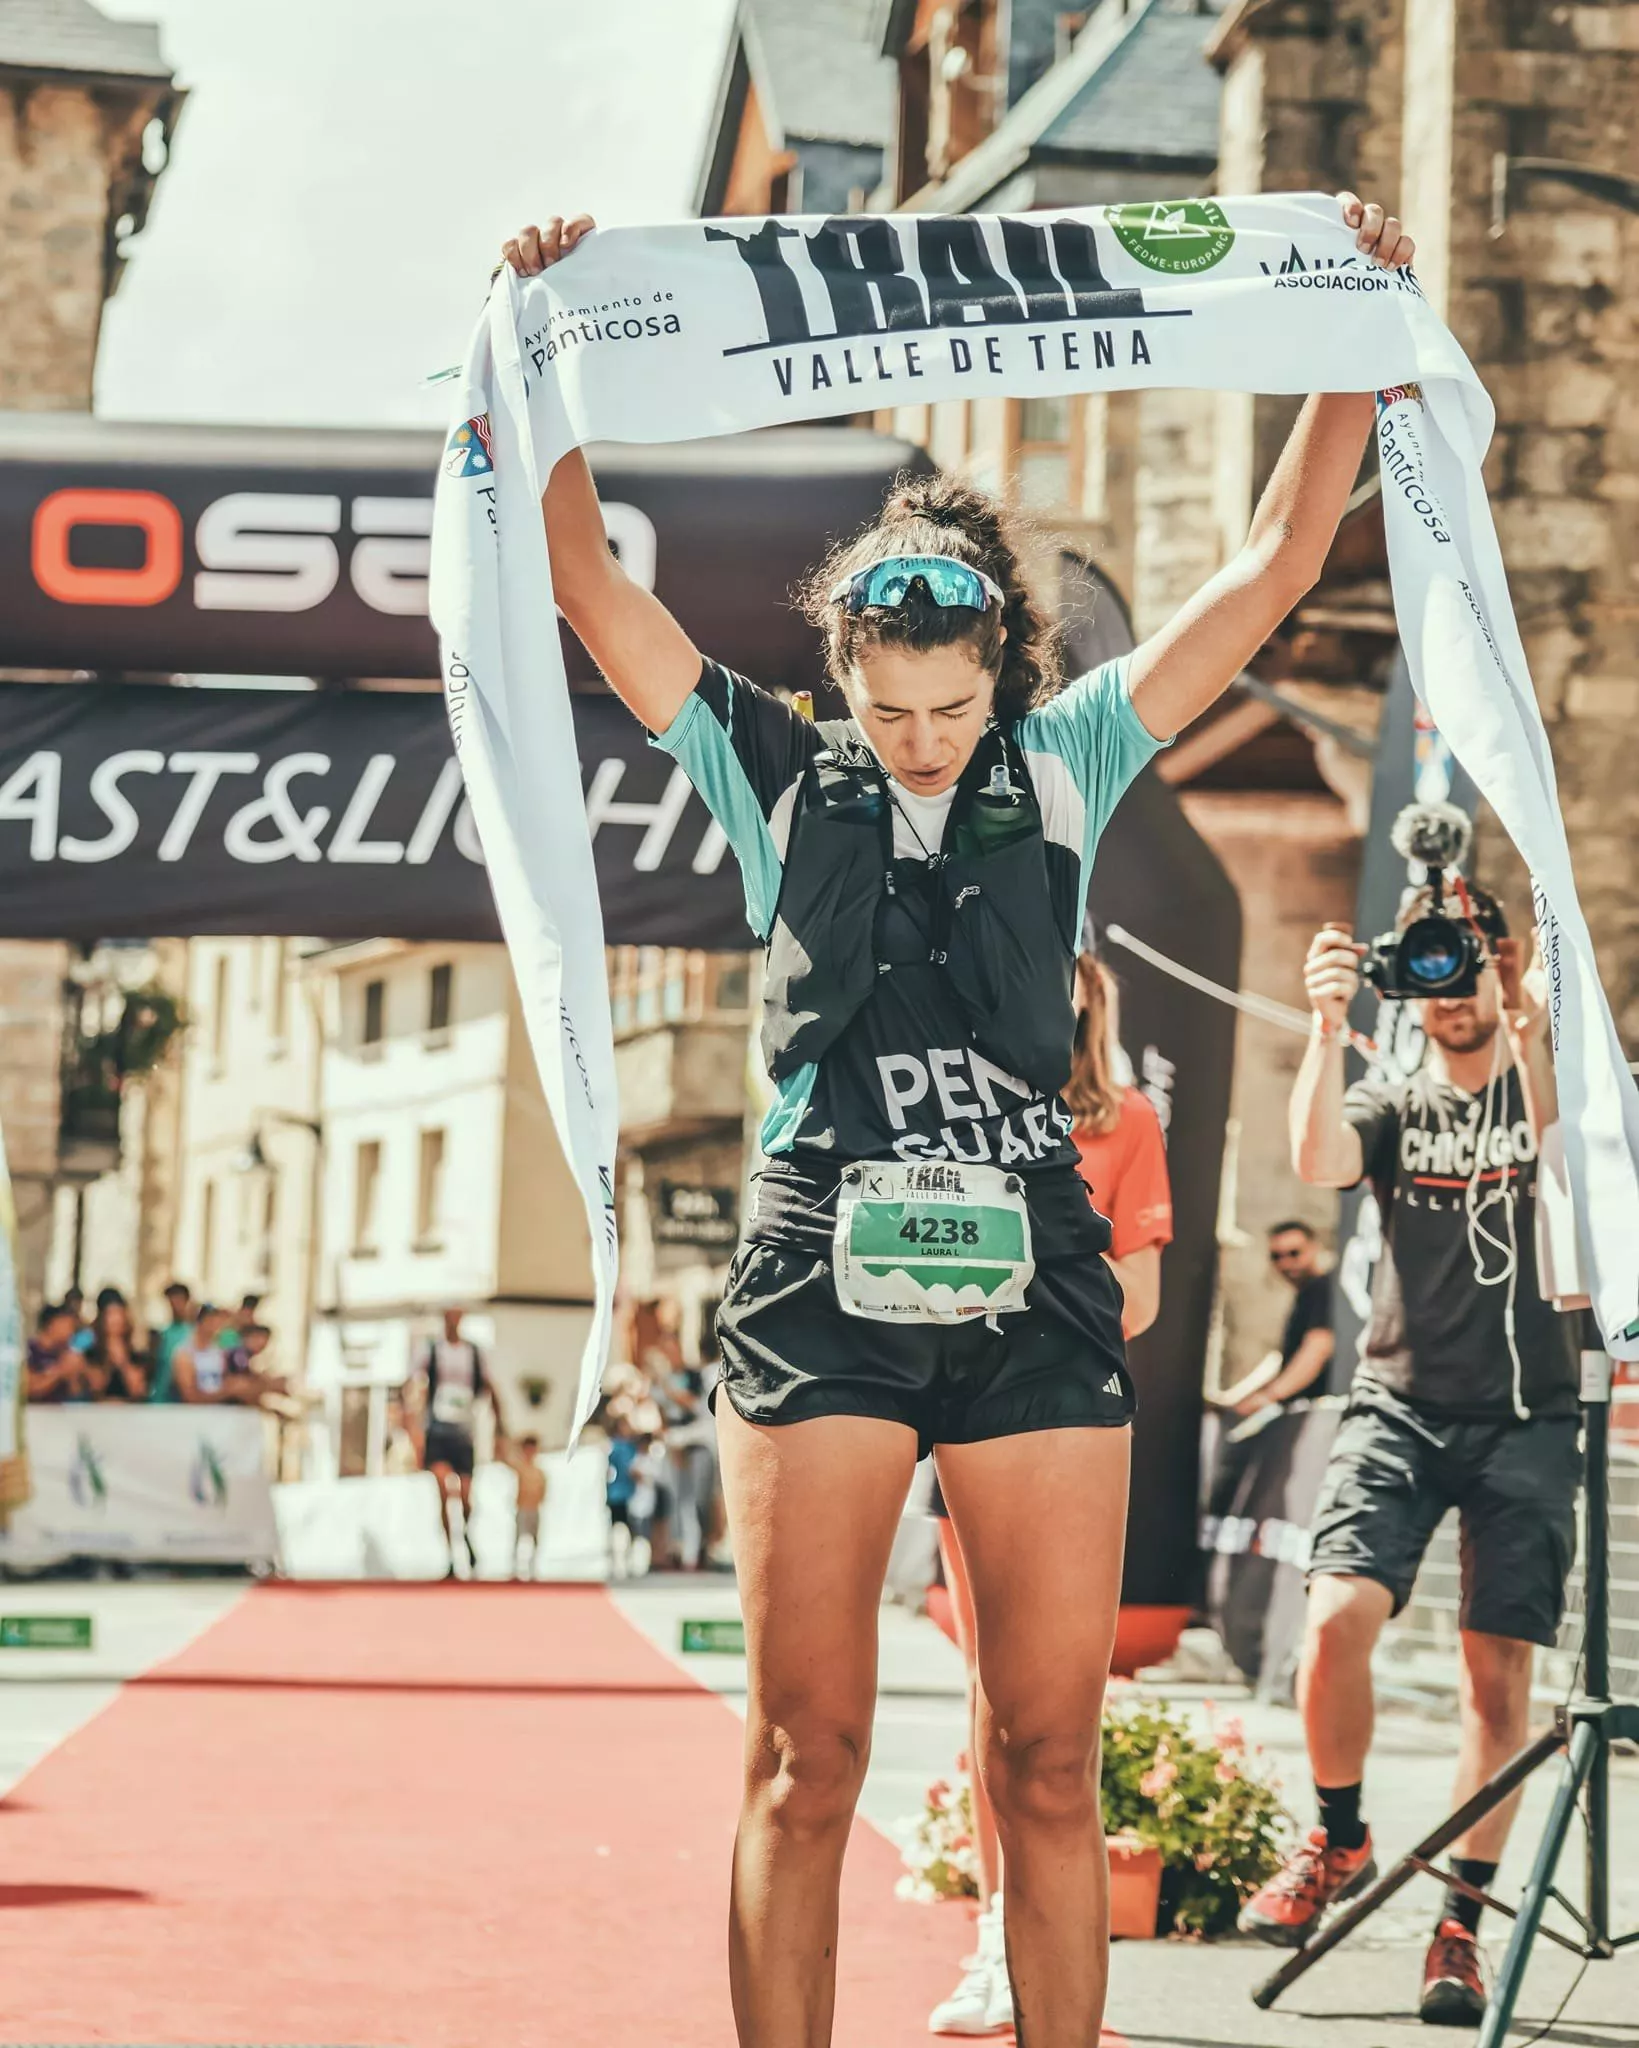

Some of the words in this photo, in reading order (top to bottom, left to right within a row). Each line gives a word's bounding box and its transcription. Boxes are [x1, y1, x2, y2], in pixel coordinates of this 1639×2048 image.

[704, 216, 1145, 344] TRAIL
[1274, 275, 1388, 291] ASOCIACION
[524, 296, 642, 349] Ayuntamiento
[653, 291, 674, 303] de
[531, 312, 682, 377] Panticosa
[772, 341, 924, 397] VALLE
[949, 336, 1003, 374] DE
[1027, 329, 1153, 371] TENA
[1379, 419, 1451, 543] Panticosa
[900, 1217, 980, 1246] 4238
[921, 1248, 953, 1257] LAURA
